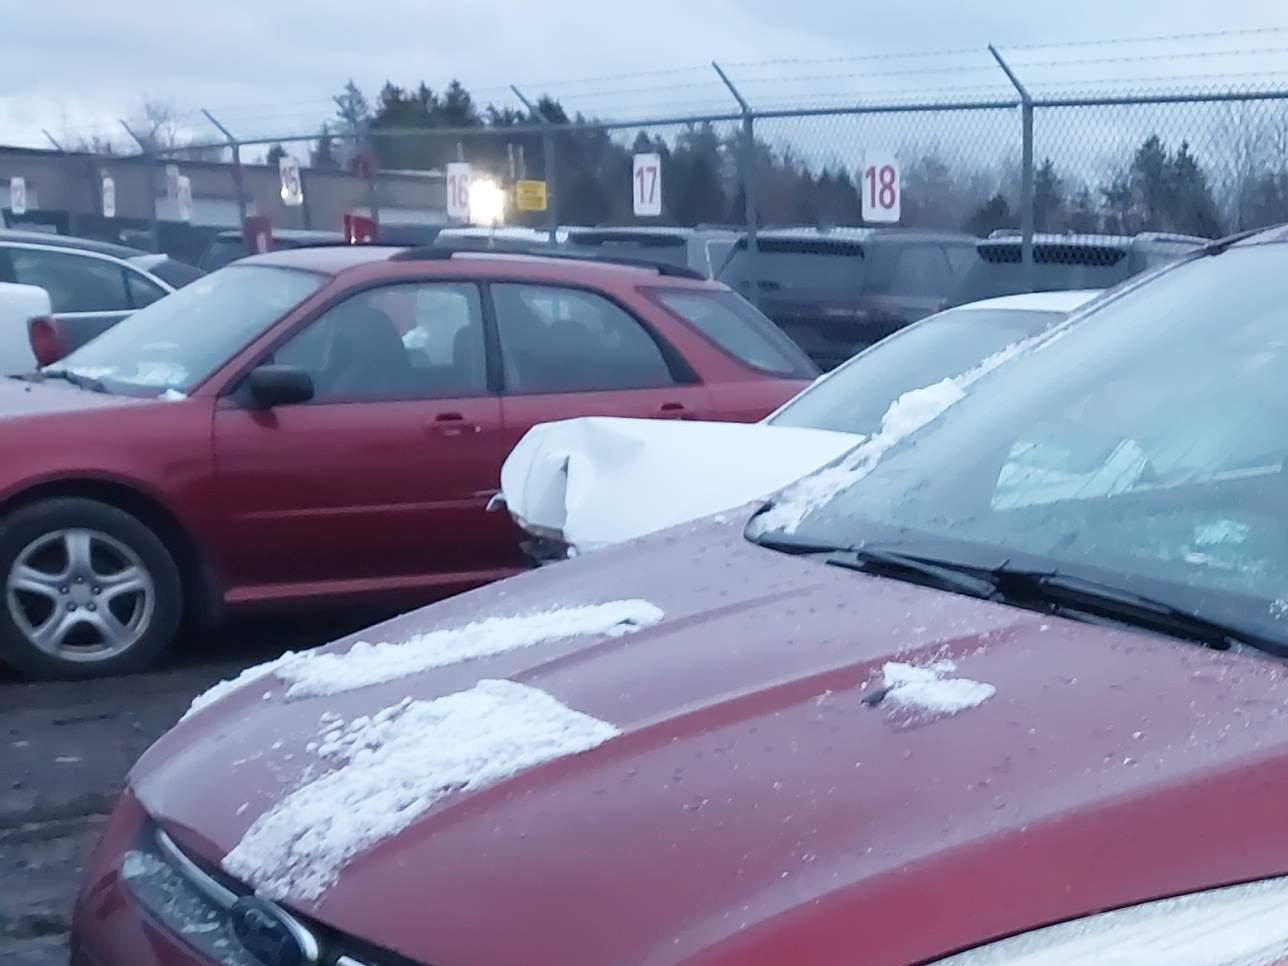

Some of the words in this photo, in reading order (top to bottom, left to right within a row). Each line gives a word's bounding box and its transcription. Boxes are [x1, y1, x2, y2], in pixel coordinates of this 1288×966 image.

[447, 172, 469, 209] 16
[634, 165, 658, 205] 17
[864, 163, 897, 210] 18
